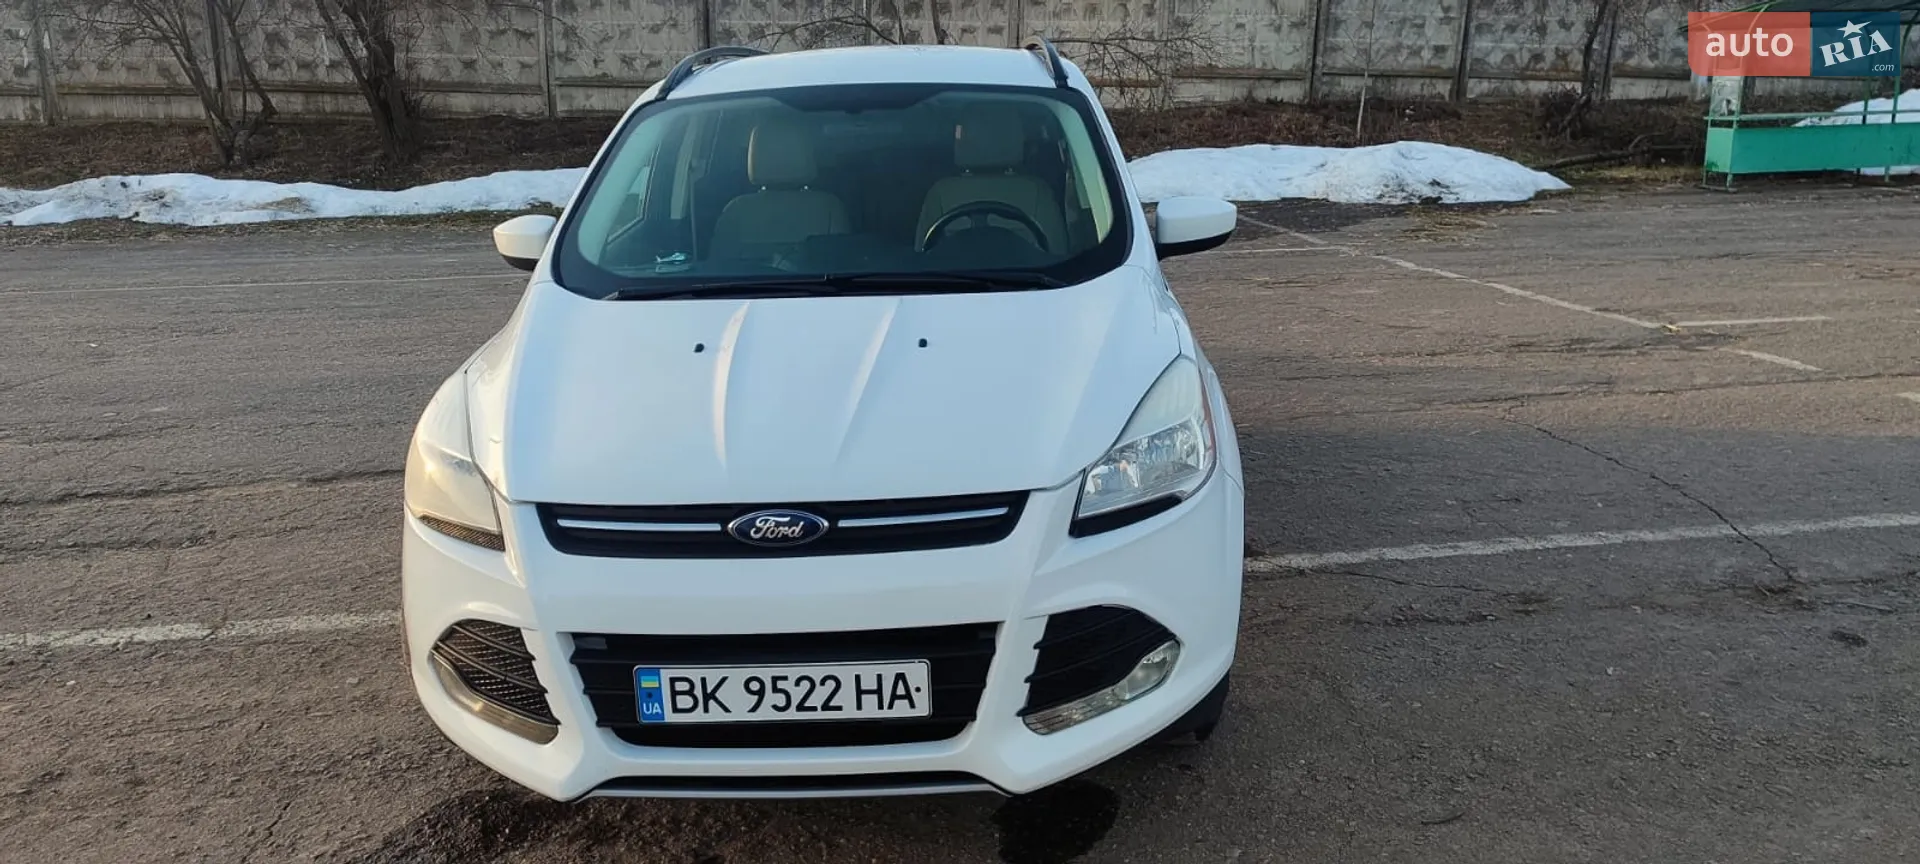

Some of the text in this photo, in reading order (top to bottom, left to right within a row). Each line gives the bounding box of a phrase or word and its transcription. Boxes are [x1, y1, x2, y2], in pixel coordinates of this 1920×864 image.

[750, 516, 804, 539] Ford
[669, 672, 916, 714] BK 9522 HA
[643, 703, 662, 715] UA
